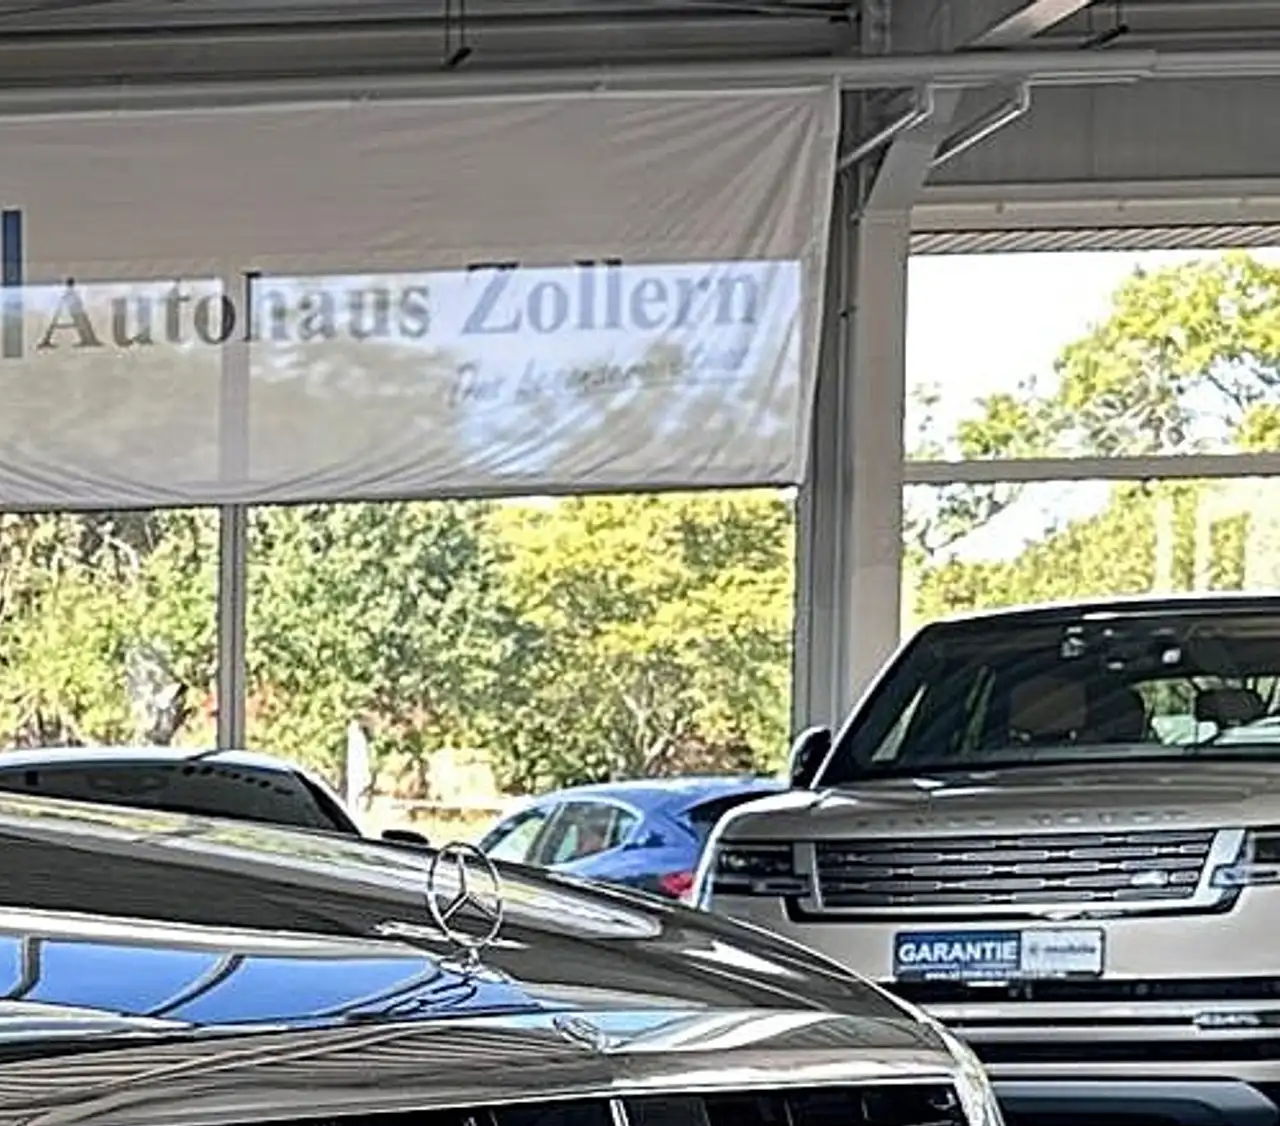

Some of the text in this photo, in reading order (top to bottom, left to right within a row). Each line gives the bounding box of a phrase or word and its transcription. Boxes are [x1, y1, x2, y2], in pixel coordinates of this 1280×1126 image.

[36, 257, 760, 350] Autohaus Zollern
[897, 940, 1017, 963] GARANTIE
